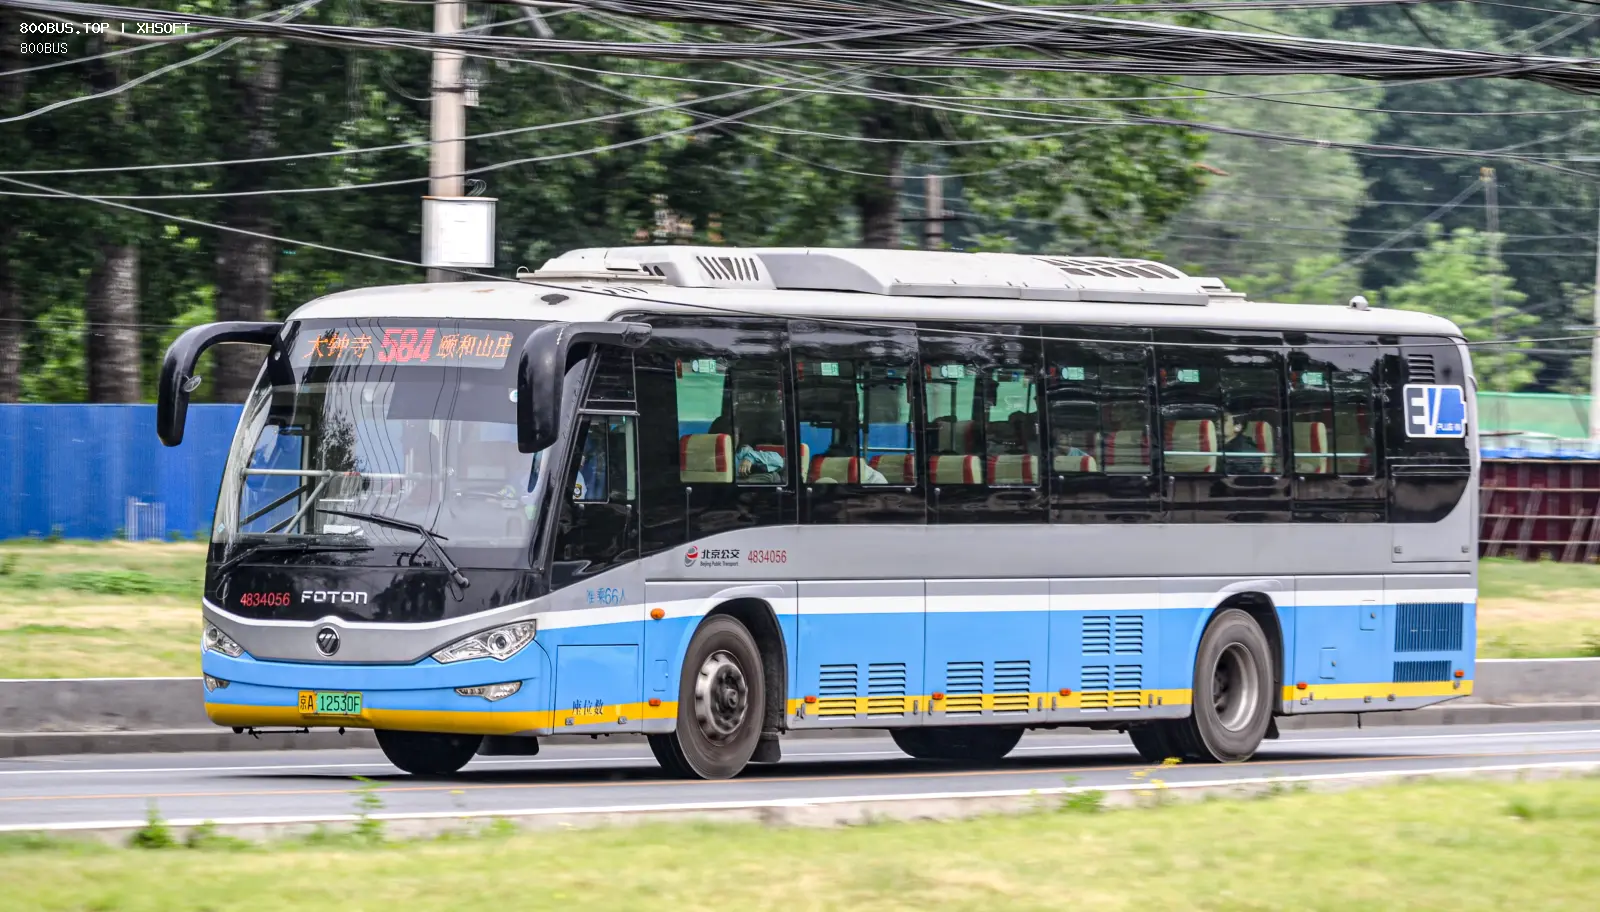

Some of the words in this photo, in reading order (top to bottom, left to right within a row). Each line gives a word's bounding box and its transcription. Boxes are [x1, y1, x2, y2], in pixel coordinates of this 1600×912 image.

[303, 333, 373, 359] 大钟寺
[377, 328, 436, 362] 584
[436, 333, 514, 359] 颐和山庄
[1406, 387, 1443, 435] EV
[701, 549, 740, 559] 北京公交
[747, 550, 787, 563] 4834056
[240, 592, 290, 606] 4834056
[301, 591, 368, 605] FOTON
